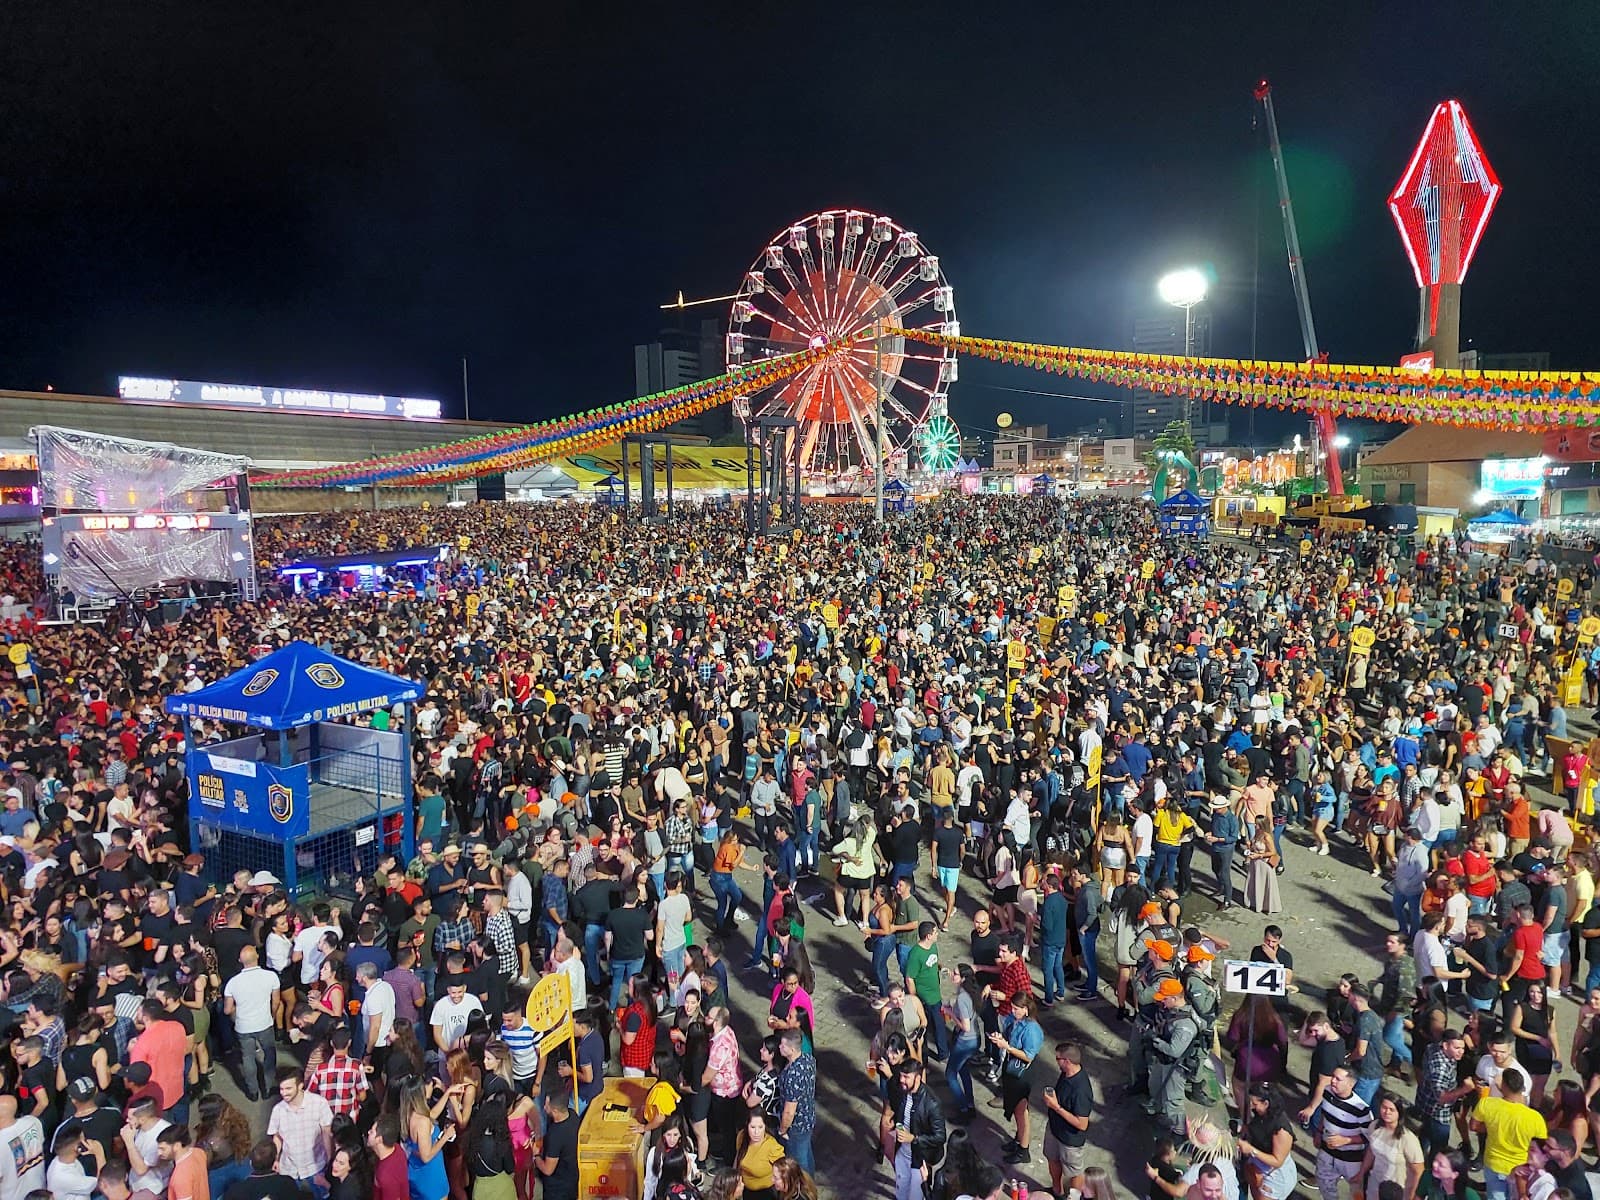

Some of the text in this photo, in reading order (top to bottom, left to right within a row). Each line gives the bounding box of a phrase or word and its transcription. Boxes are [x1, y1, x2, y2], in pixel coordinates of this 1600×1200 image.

[1501, 626, 1515, 636] 13
[198, 704, 222, 718] POLÍCIA
[222, 708, 247, 721] MILITAR
[326, 701, 357, 719] POLÍCIA
[357, 695, 389, 711] MILITAR
[198, 774, 224, 790] POLÍCIA
[199, 786, 225, 801] MILITAR
[1233, 967, 1280, 992] 14
